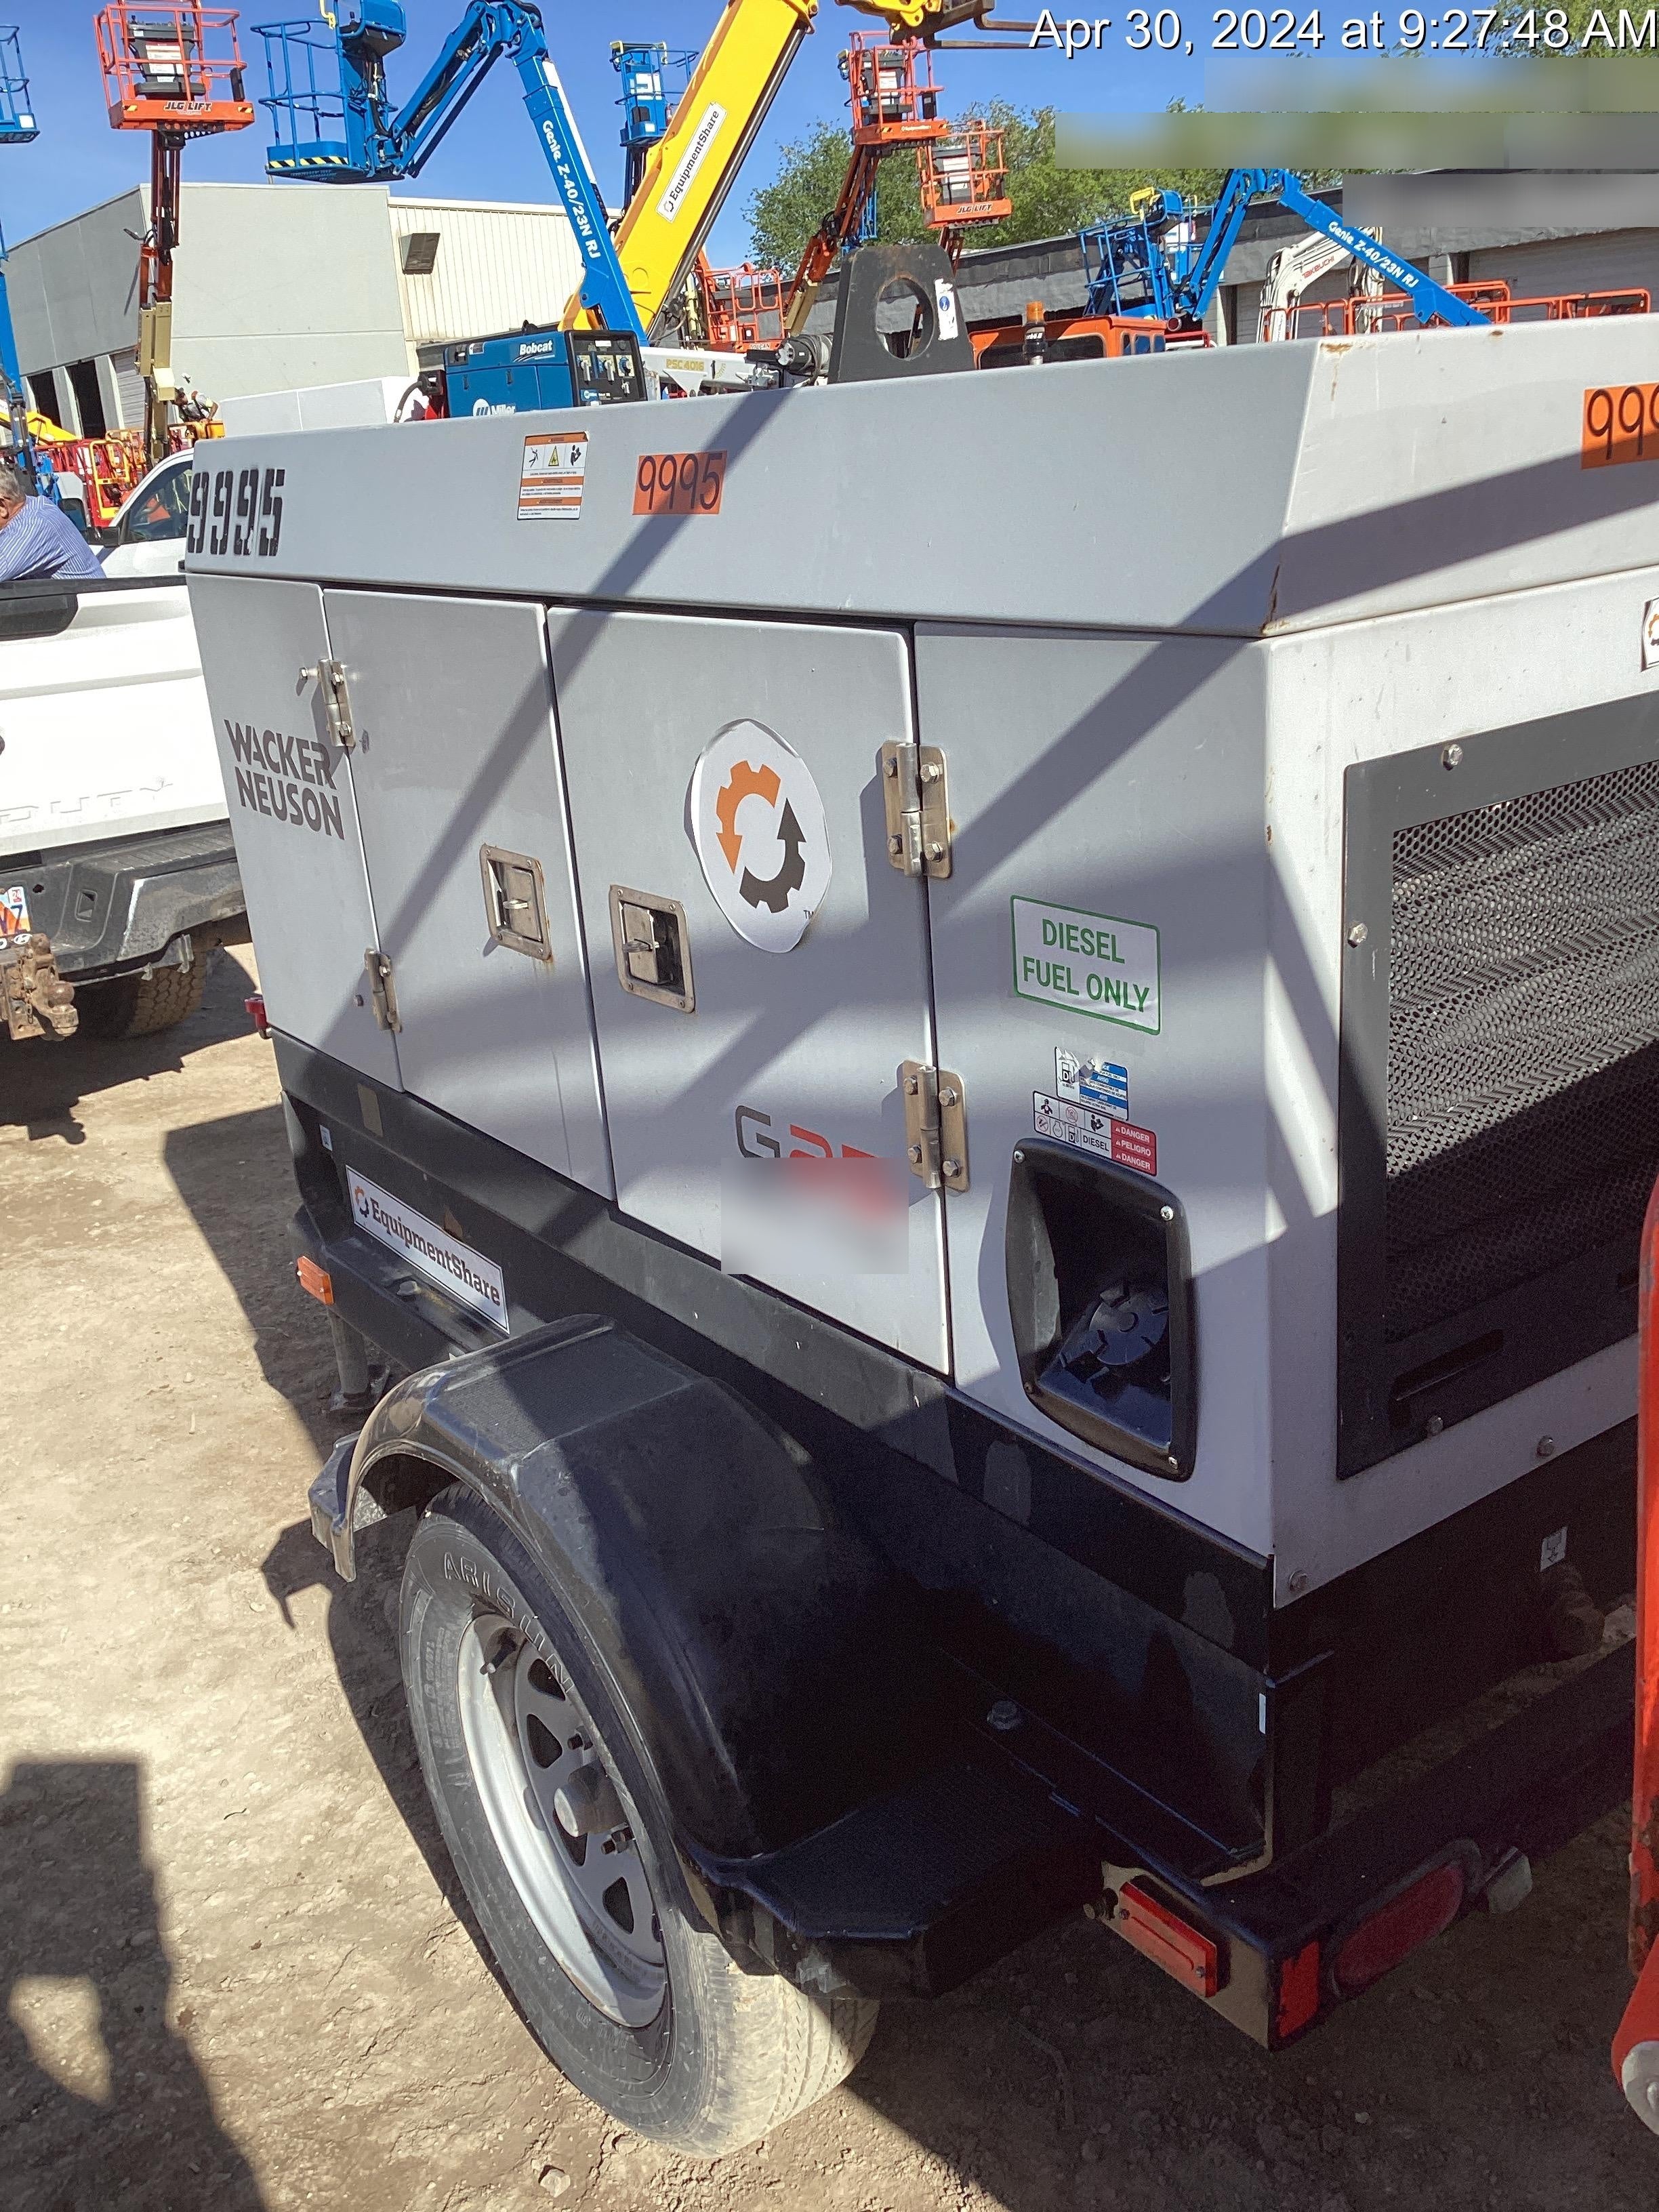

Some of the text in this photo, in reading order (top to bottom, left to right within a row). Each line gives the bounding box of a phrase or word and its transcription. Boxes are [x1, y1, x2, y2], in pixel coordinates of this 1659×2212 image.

[165, 101, 212, 111] JLG LIFT
[670, 110, 719, 201] EquipmentShare
[543, 120, 601, 259] Genie Z-40/23N RJ
[957, 203, 992, 213] JLG LIFT
[1328, 222, 1419, 287] Genie Z-40/23N RJ
[519, 340, 553, 356] Bobcat
[491, 404, 516, 415] Miller
[638, 453, 724, 510] 9995
[187, 469, 285, 556] 9995
[224, 719, 337, 790] WACKER
[234, 766, 345, 840] NEUSON
[1042, 918, 1125, 964] DIESEL
[1023, 956, 1150, 1012] FUEL ONLY
[1083, 1134, 1109, 1152] DIESEL
[1121, 1126, 1150, 1143] DANGER
[1121, 1139, 1151, 1158] PELIGRO
[1121, 1153, 1151, 1170] DANGER
[370, 1197, 500, 1306] EquipmentShare
